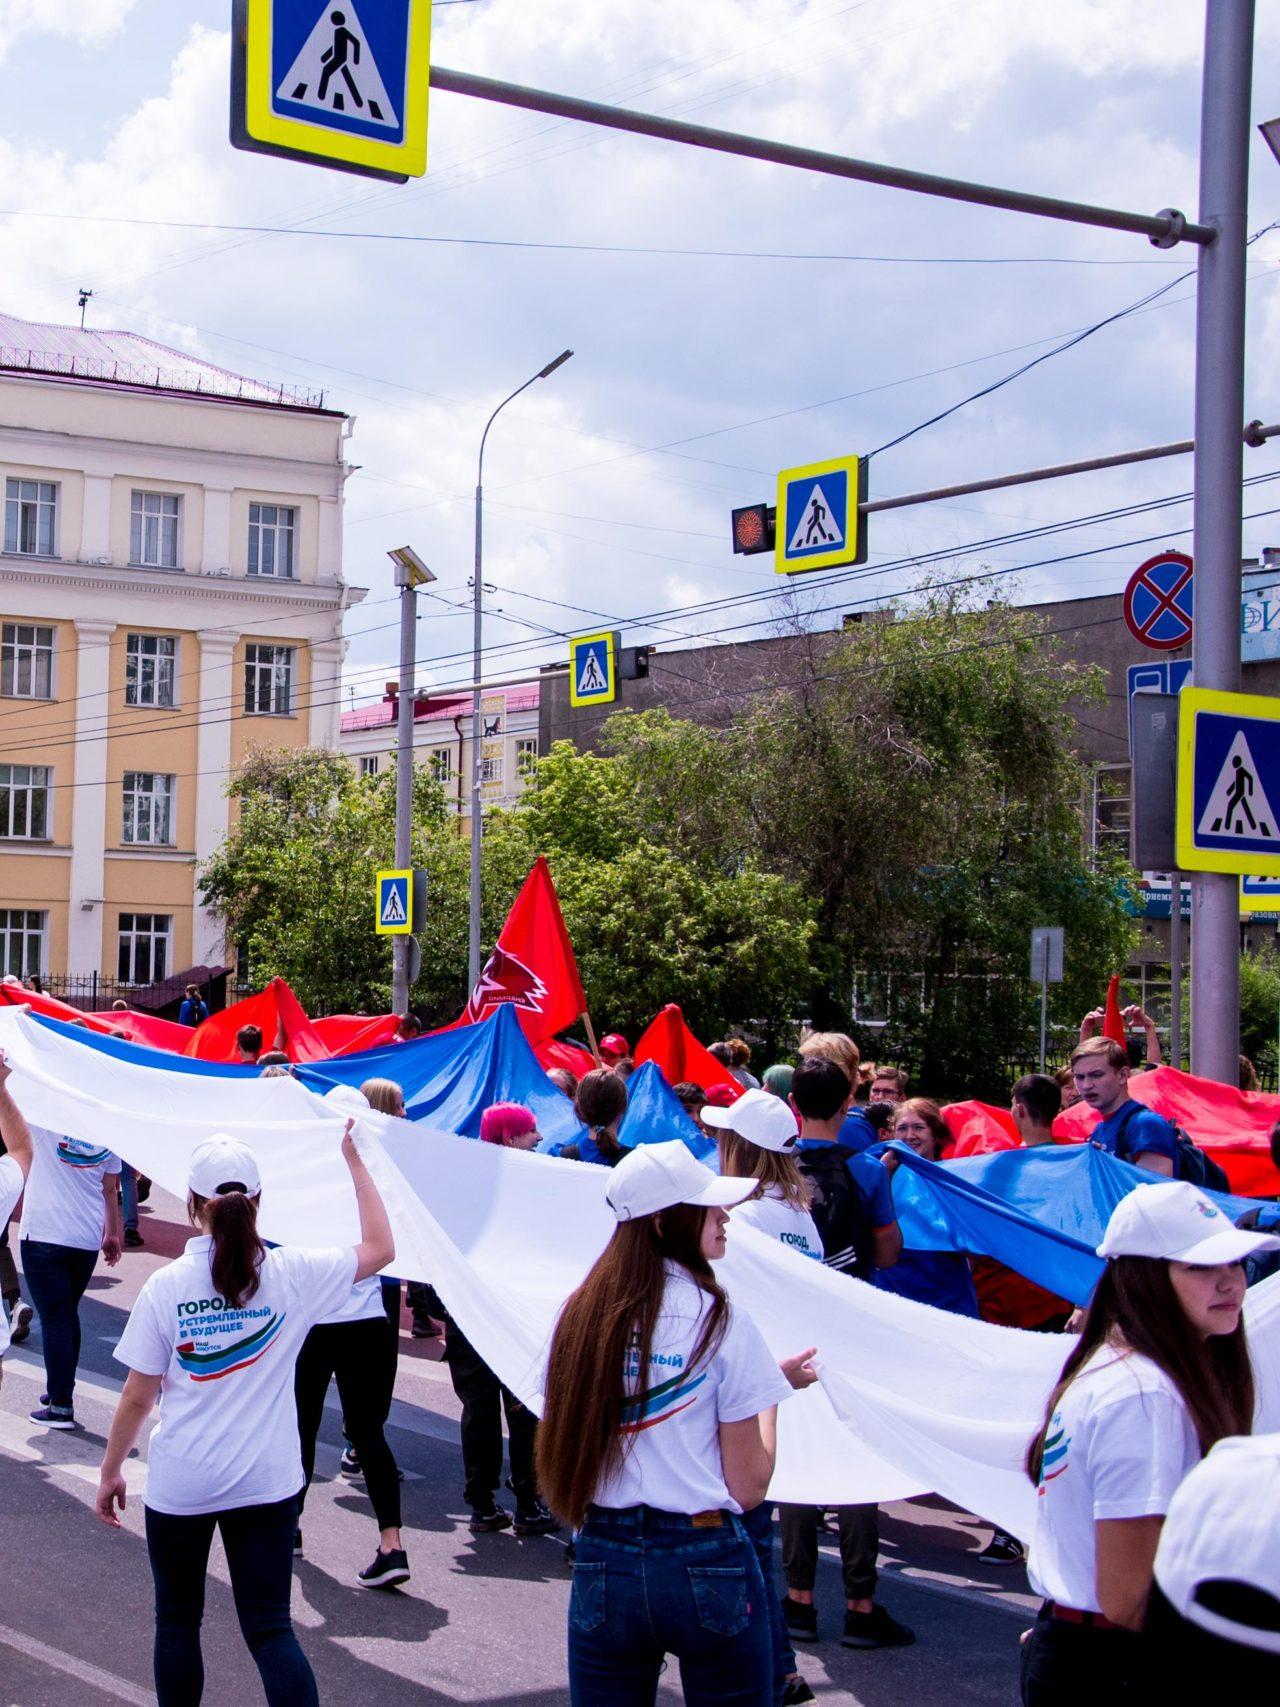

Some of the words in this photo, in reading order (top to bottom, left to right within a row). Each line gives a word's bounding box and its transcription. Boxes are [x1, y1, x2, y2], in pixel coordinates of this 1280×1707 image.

[780, 1232, 810, 1250] ГОРОД,
[179, 1306, 271, 1328] УСТРЕМЛЕННЫЙ
[180, 1330, 188, 1338] В
[190, 1322, 244, 1338] БУДУЩЕЕ
